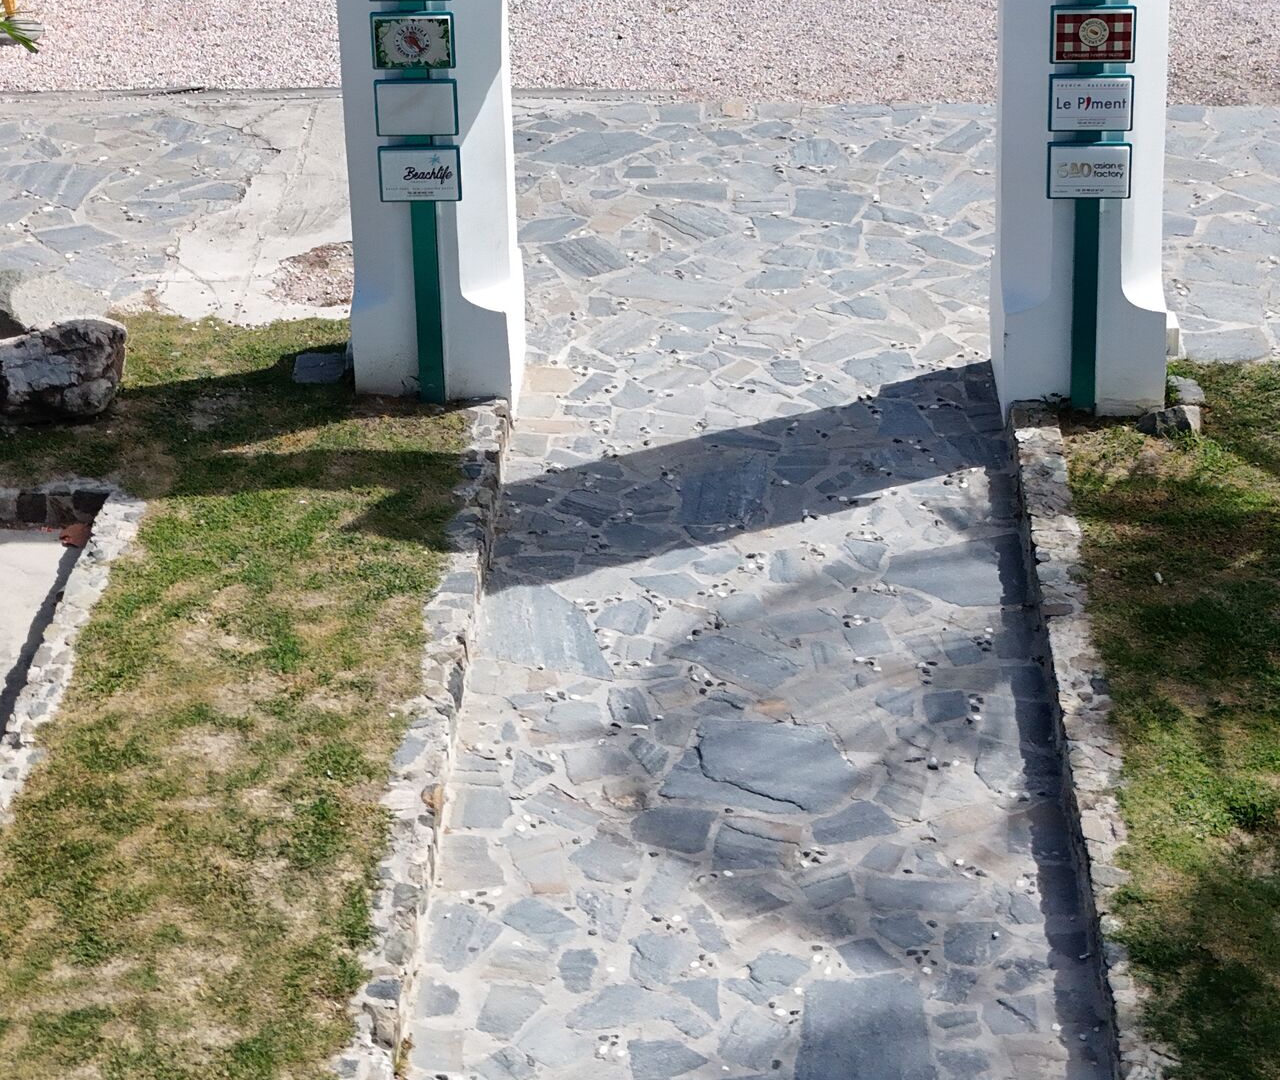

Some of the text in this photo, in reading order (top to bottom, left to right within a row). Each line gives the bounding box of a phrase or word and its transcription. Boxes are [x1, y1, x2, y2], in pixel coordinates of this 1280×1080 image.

[1056, 97, 1071, 109] Le
[1093, 162, 1115, 170] asian
[403, 165, 453, 185] Beachlife
[1093, 170, 1124, 178] factory
